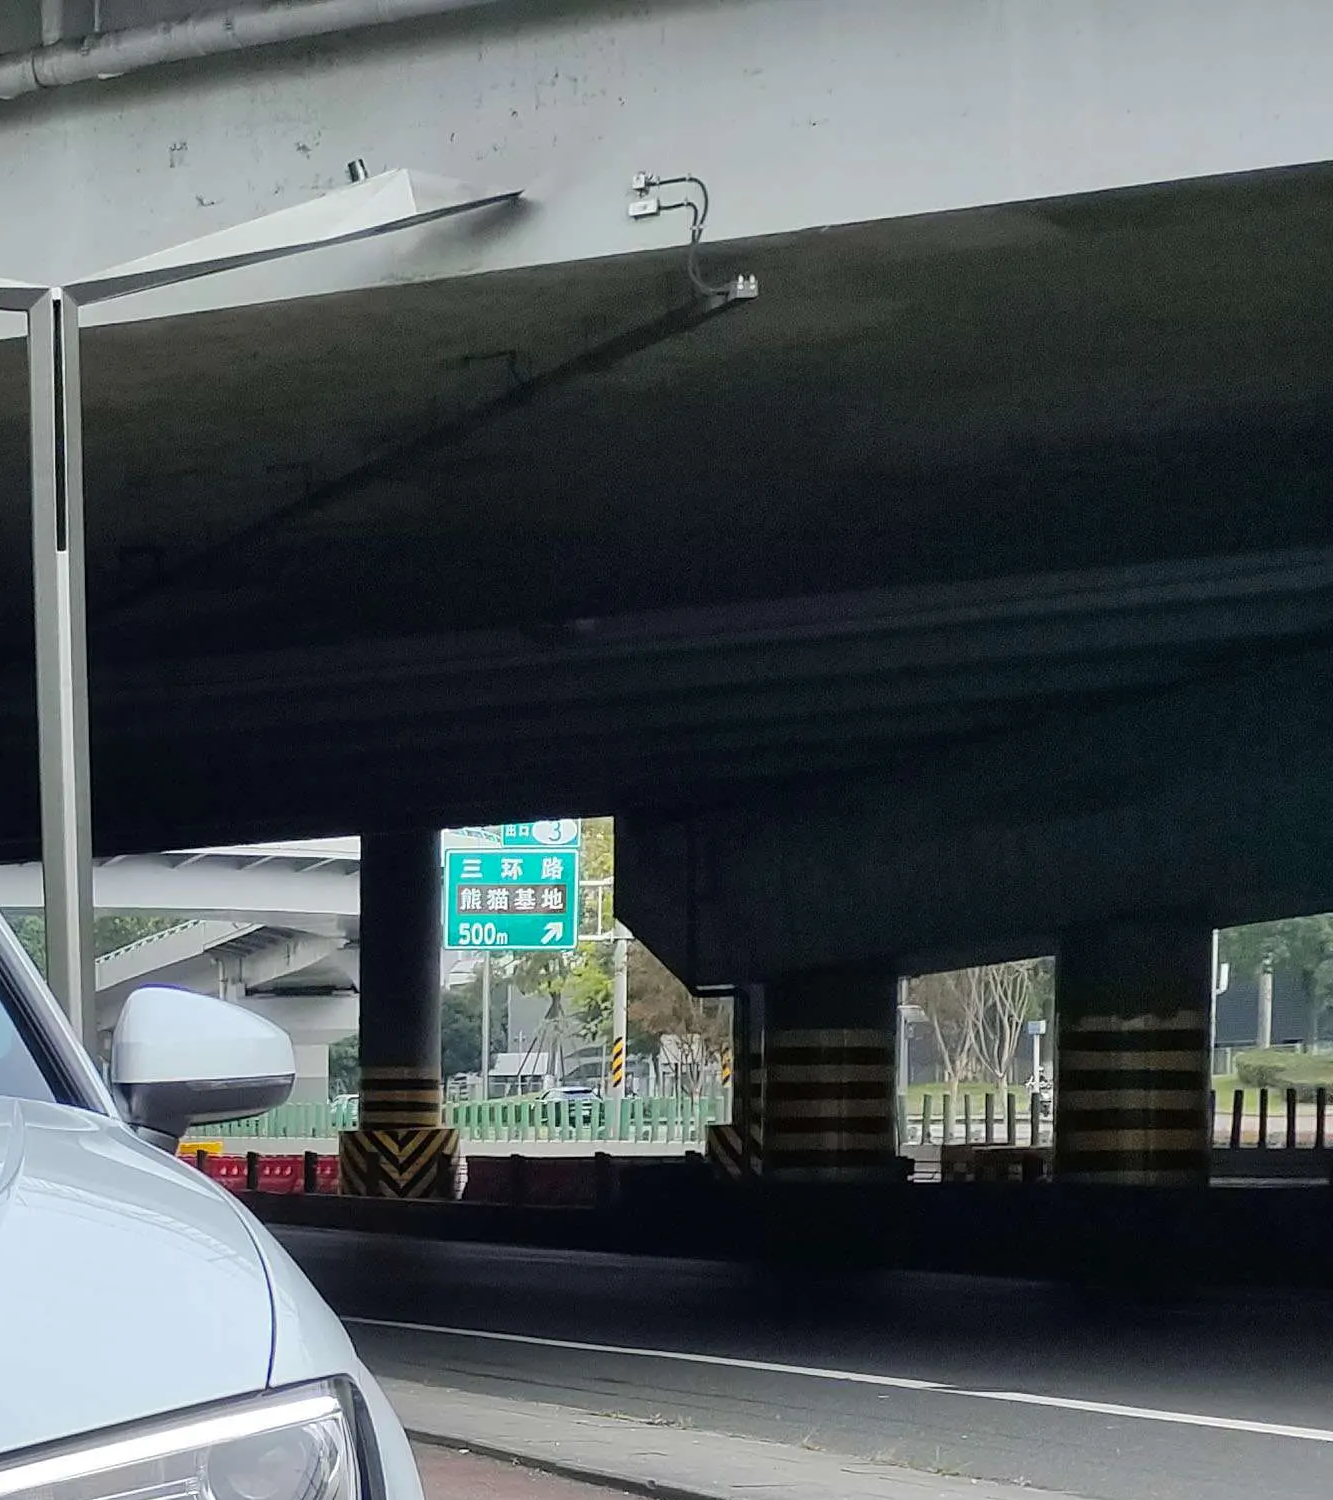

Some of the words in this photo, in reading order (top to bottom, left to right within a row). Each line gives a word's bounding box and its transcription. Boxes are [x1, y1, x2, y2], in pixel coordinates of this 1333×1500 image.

[505, 824, 530, 837] 出口
[548, 821, 562, 841] 3
[460, 857, 564, 880] 三环路
[460, 888, 564, 910] 熊猫基地
[458, 922, 508, 945] 500m
